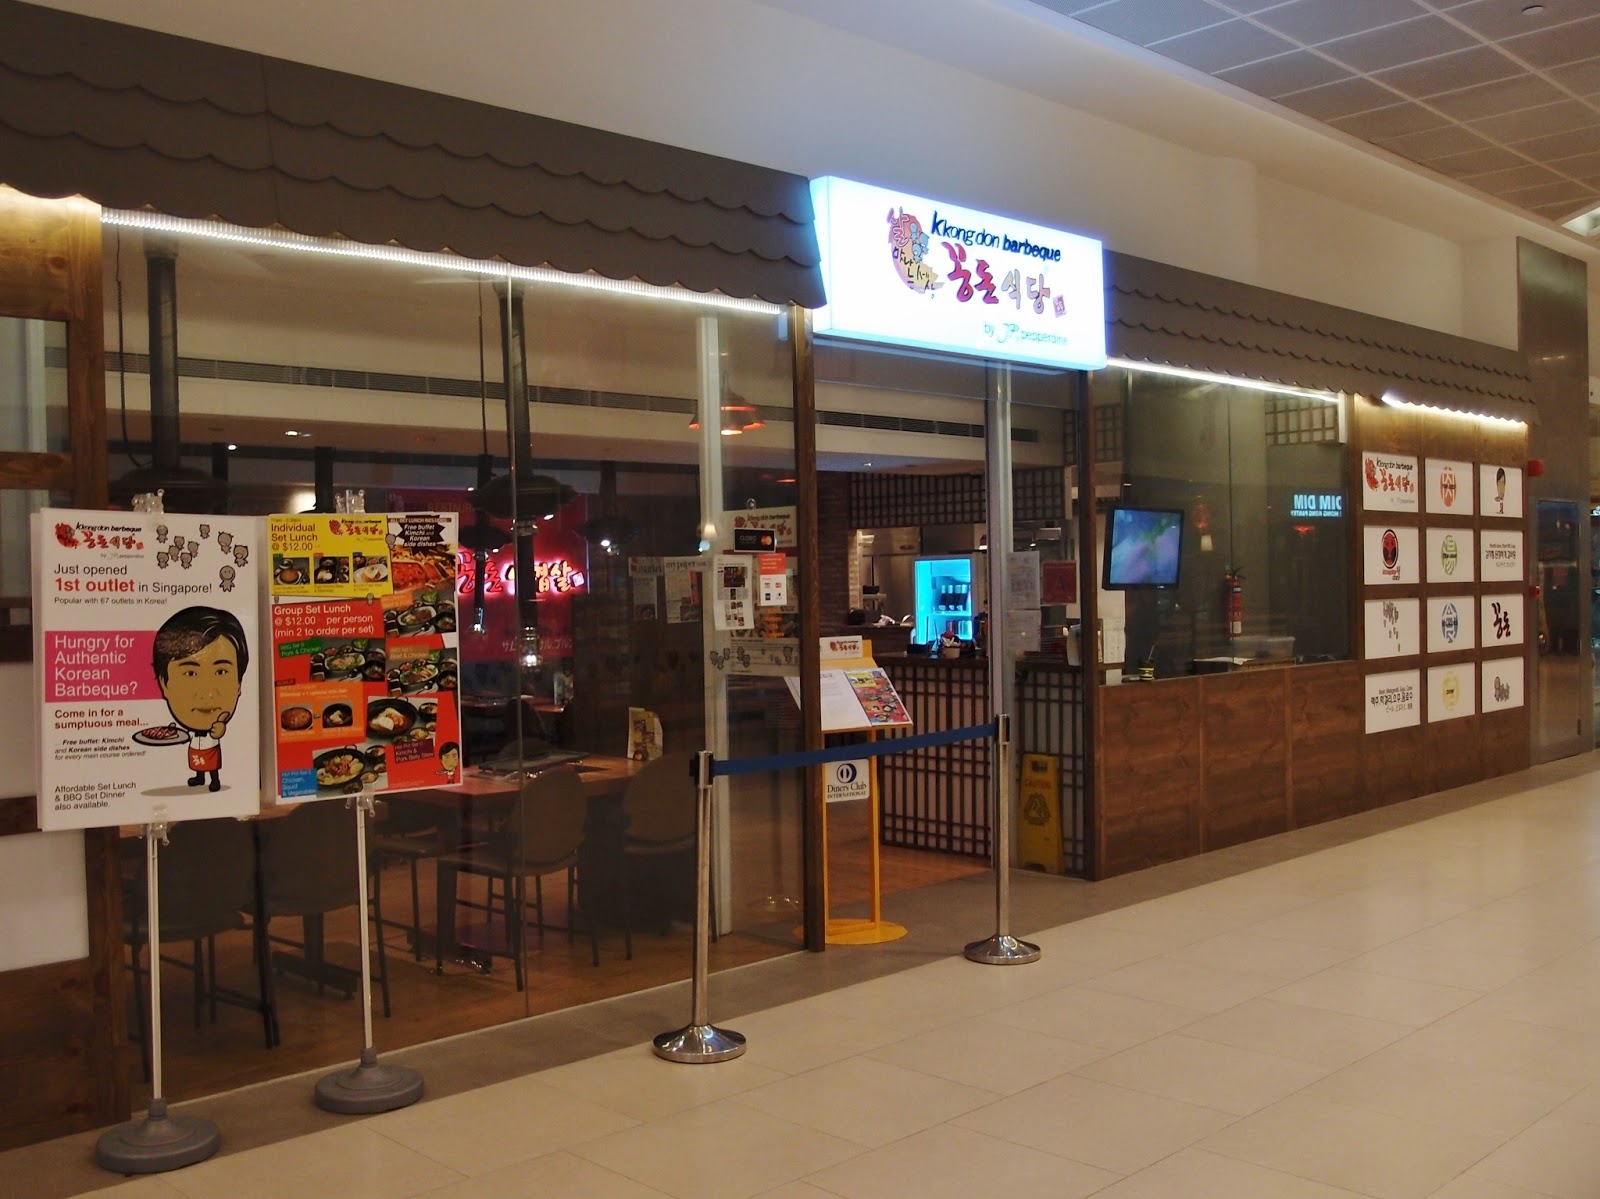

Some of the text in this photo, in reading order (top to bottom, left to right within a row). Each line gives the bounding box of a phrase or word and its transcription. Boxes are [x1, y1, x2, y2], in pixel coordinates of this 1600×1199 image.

[1003, 234, 1061, 262] barbeque
[271, 523, 316, 532] Individual
[271, 533, 318, 542] Set Lunch
[271, 542, 313, 551] @ $12.00
[54, 563, 128, 577] Just opened
[55, 577, 213, 595] 1st outlet in Singapore!
[54, 596, 82, 606] Popular
[84, 597, 99, 605] with
[111, 597, 135, 605] outlets
[136, 597, 143, 605] in
[144, 597, 167, 605] Korea!
[274, 604, 351, 616] Group Set Lunch
[274, 616, 373, 626] @ $12.00 per person
[274, 625, 374, 638] (min 2 to order per set)
[55, 635, 135, 652] Hungry for
[54, 651, 127, 665] Authentic
[55, 667, 110, 681] Korean
[55, 681, 138, 699] Barbeque?
[54, 708, 124, 719] Come in for a
[54, 719, 113, 730] sumptuous
[54, 782, 137, 793] Affordable Set Lunch
[827, 781, 867, 793] Diners Club
[1024, 778, 1051, 789] CAUTION
[54, 791, 126, 802] & BBQ Set Dinner
[54, 802, 72, 811] also
